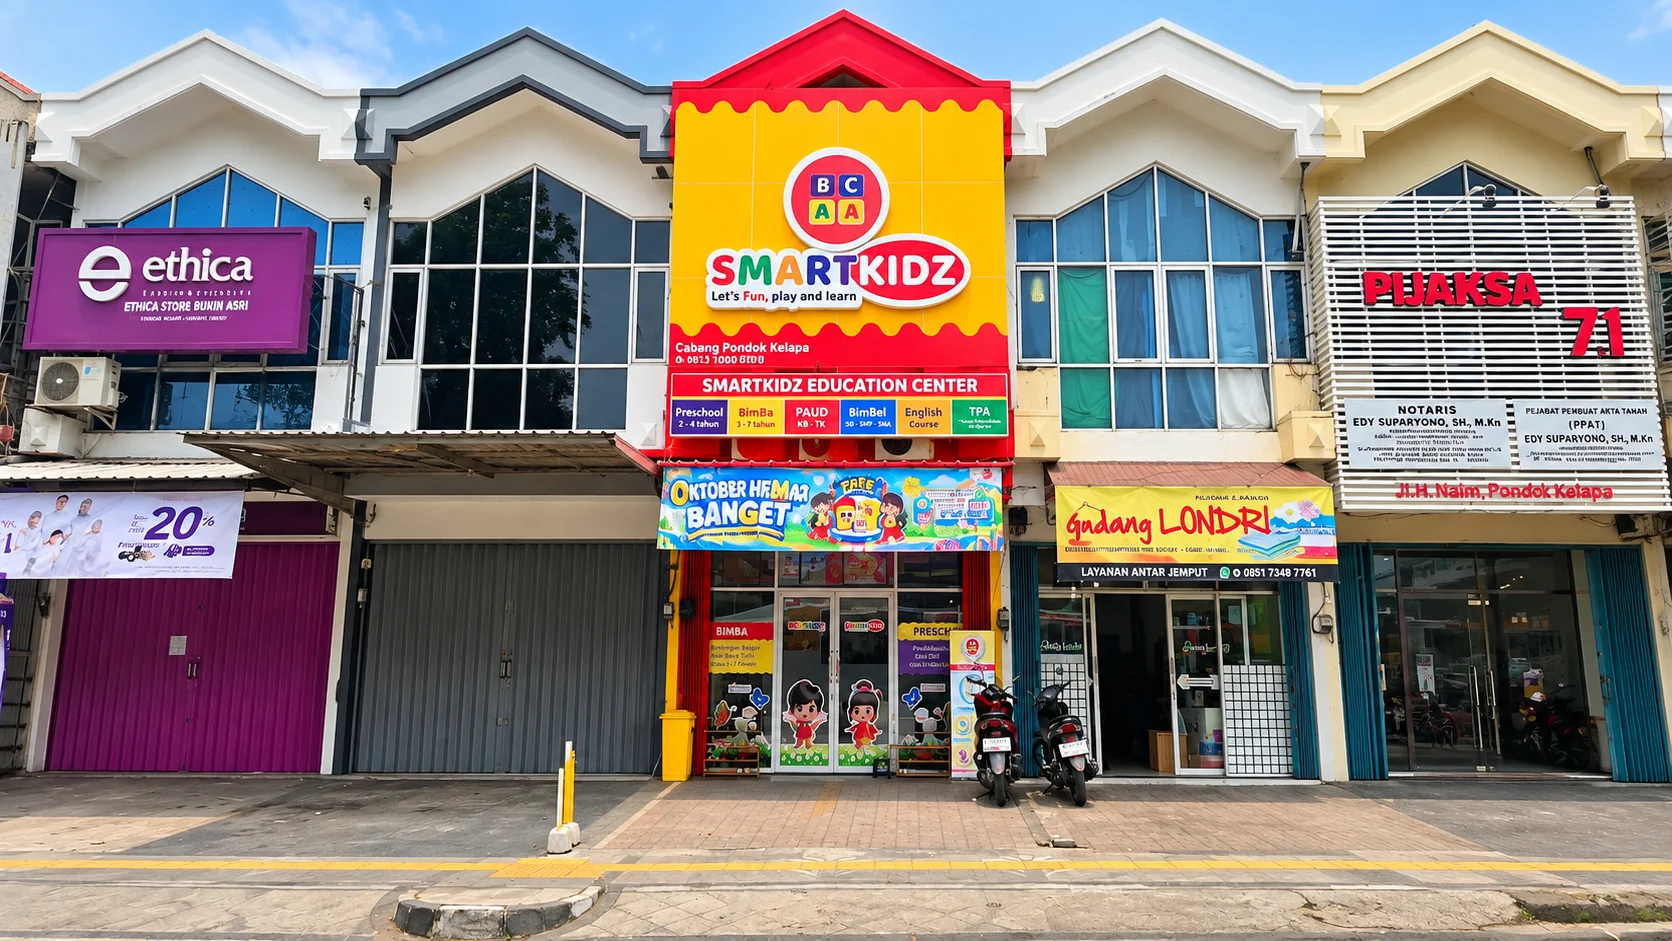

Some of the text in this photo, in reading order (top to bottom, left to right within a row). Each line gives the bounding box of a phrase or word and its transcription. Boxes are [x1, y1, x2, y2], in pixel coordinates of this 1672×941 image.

[816, 177, 858, 193] B C
[814, 203, 859, 220] A A
[142, 247, 254, 282] ethica
[1362, 271, 1543, 306] PIJAKSA
[711, 290, 857, 304] Let's Fun, play and learn
[123, 301, 159, 312] ETHICA
[160, 301, 191, 312] STORE
[225, 300, 249, 311] ASRI
[675, 342, 810, 355] Cabang Pondok Kelapa
[702, 377, 978, 393] SMARTKIDZ EDUCATION CENTER
[675, 407, 724, 418] Preschool
[738, 407, 774, 418] BimBa
[795, 407, 829, 418] PAUD
[848, 407, 887, 418] BimBel
[905, 407, 943, 419] English
[968, 406, 991, 417] TPA
[1397, 405, 1457, 415] NOTARIS
[678, 420, 684, 428] 2
[696, 420, 720, 428] tahun
[753, 420, 776, 428] tahun
[814, 420, 826, 428] TK
[909, 420, 939, 429] Course
[1353, 418, 1375, 427] EDY
[1378, 417, 1449, 428] SUPARYONO,
[1474, 418, 1501, 427] M.Kn
[1568, 420, 1606, 431] (PPAT)
[1524, 434, 1544, 444] EDY
[1545, 434, 1609, 444] SUPARYONO,
[1630, 434, 1654, 443] M.Kn
[1435, 482, 1486, 500] Naim,
[1487, 482, 1551, 498] Pondok
[1554, 483, 1614, 502] Kelapa
[686, 500, 792, 529] BANGET
[1158, 504, 1272, 535] LONDRI
[1081, 567, 1317, 578] LAYANAN ANTAR JEMPUT 0851 7348 7761
